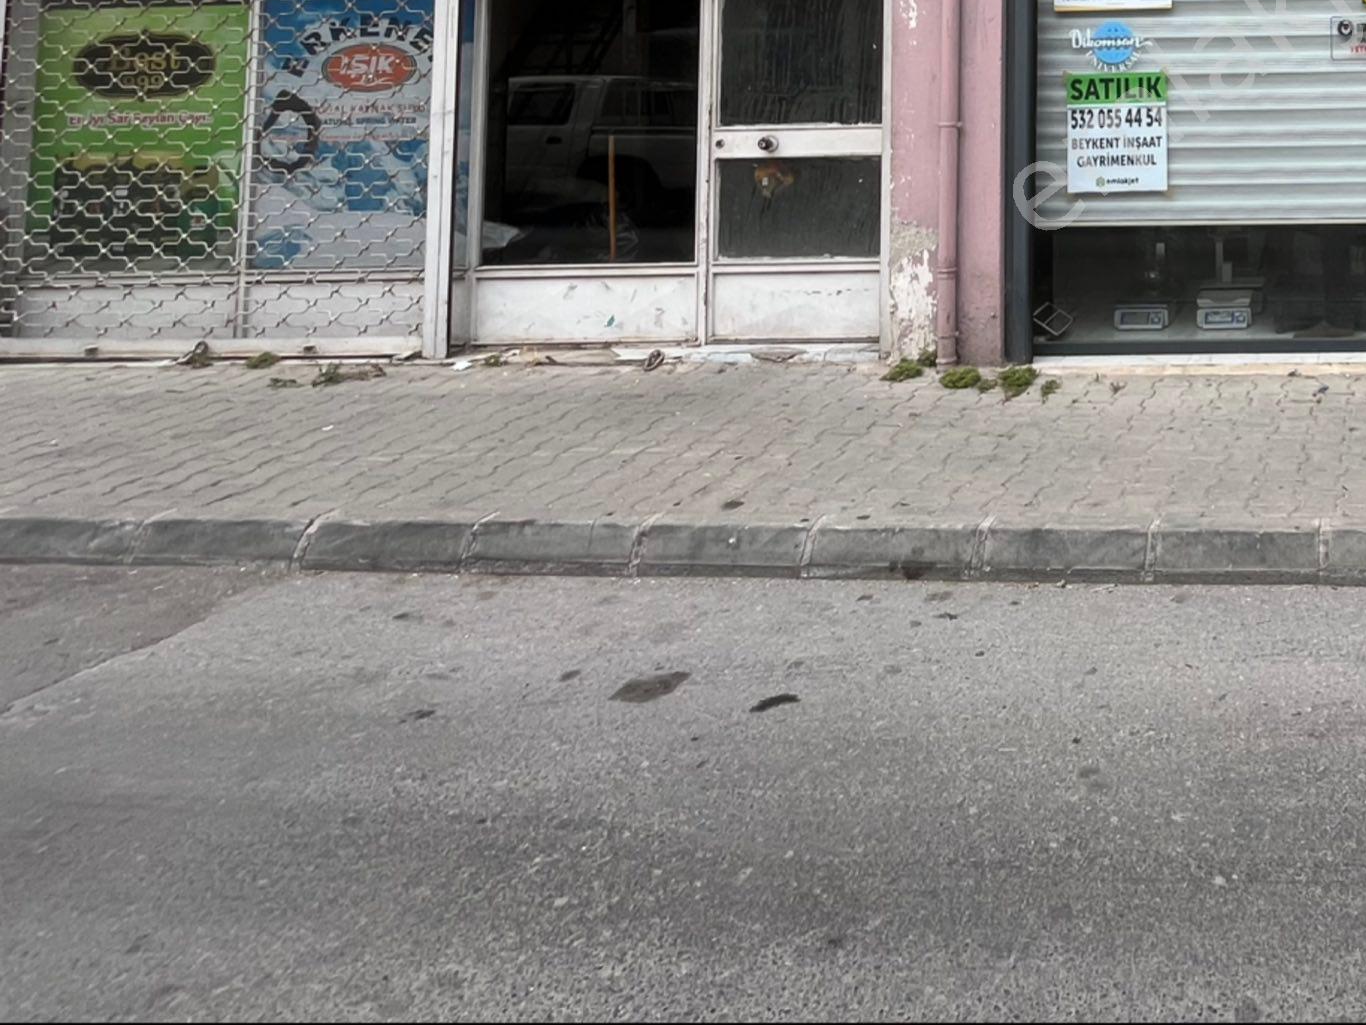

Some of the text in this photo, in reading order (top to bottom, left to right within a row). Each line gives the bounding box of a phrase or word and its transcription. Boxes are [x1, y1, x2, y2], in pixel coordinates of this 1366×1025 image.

[1070, 76, 1163, 101] SATILIK
[1071, 106, 1162, 130] 532 055 44 54
[1071, 134, 1162, 150] BEYKENT İNŞAAT
[1077, 152, 1157, 167] GAYRİMENKUL
[1106, 177, 1139, 185] emlakjet
